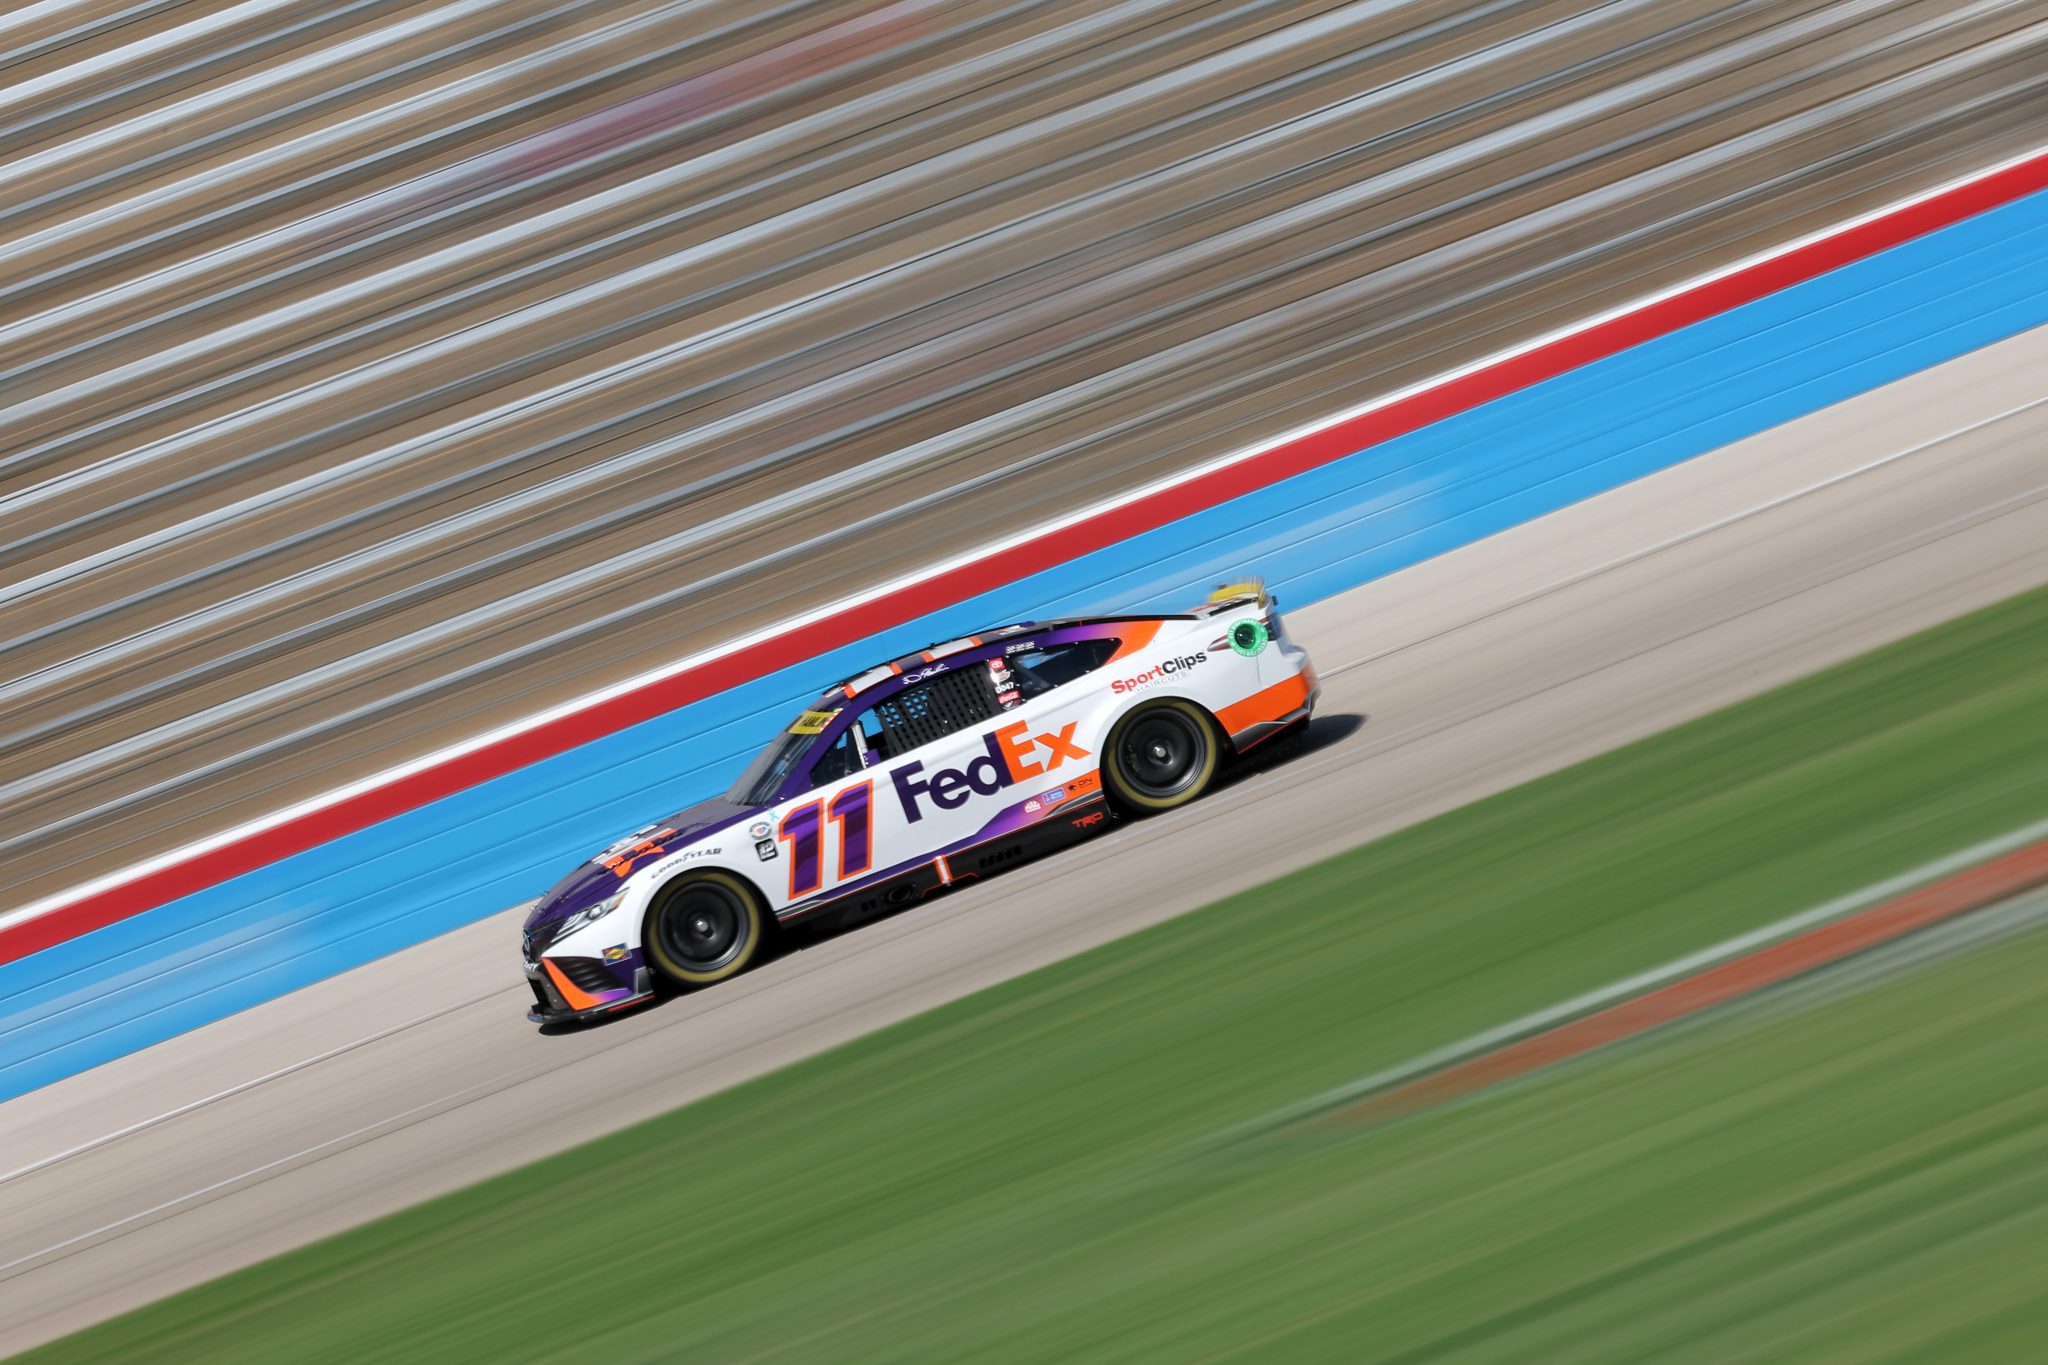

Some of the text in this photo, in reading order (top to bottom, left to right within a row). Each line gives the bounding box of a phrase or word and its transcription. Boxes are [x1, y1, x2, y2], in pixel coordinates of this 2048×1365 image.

[889, 719, 1093, 824] FedEx
[1071, 811, 1104, 828] TRD
[778, 778, 873, 901] 11
